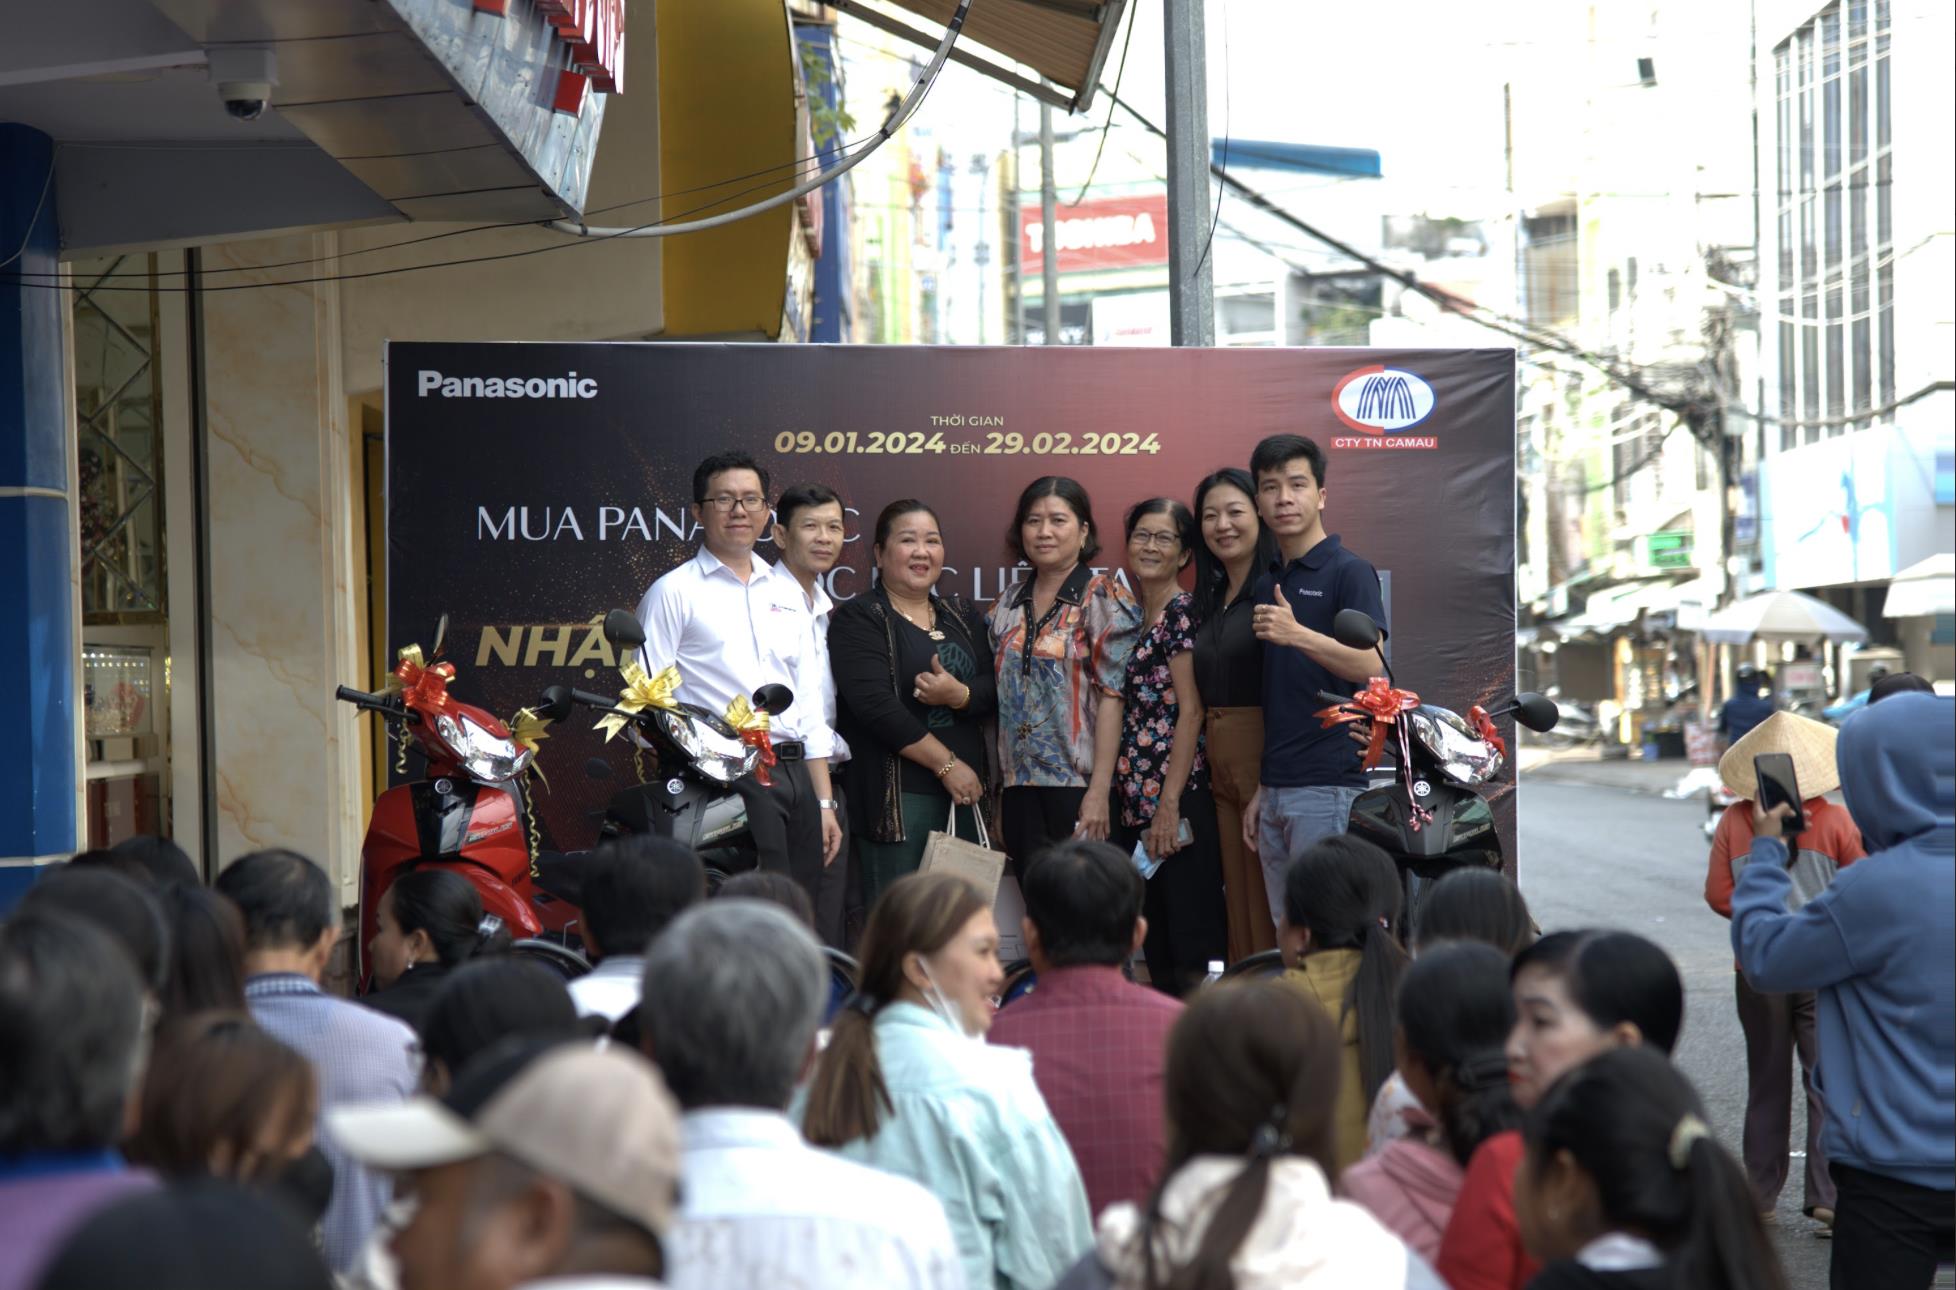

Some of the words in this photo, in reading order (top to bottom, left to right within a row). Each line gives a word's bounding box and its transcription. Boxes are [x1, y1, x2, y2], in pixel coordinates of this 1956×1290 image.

[418, 370, 598, 398] Panasonic
[930, 413, 965, 427] THỜI
[968, 415, 1004, 427] GIAN
[774, 430, 947, 454] 09.01.2024
[950, 440, 981, 454] ĐẾN
[983, 432, 1161, 455] 29.02.2024
[1335, 437, 1361, 448] CTY
[1364, 437, 1382, 448] TN
[1385, 437, 1434, 448] CAMAU
[478, 506, 584, 541] MUA
[475, 612, 636, 680] NHẬ
